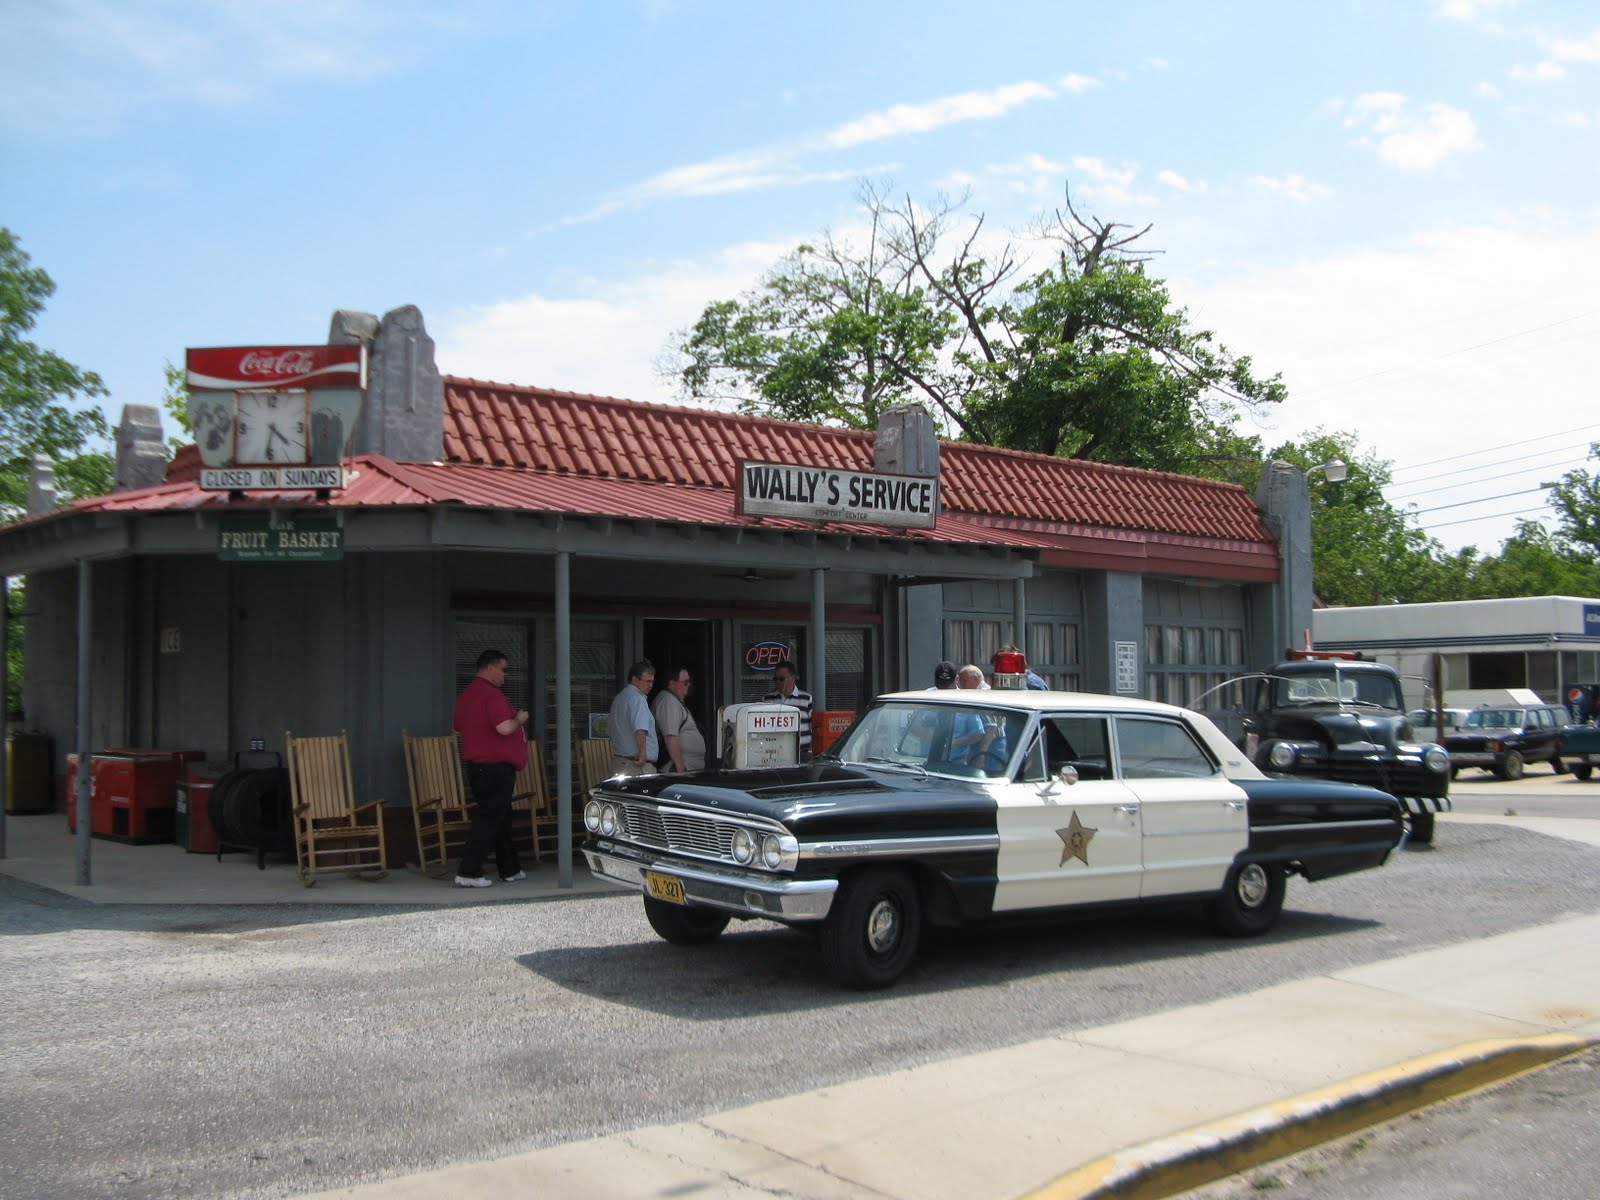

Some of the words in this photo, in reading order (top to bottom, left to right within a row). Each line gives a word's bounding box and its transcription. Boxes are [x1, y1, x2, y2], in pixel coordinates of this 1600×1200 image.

[205, 471, 252, 487] CLOSED
[260, 471, 277, 487] ON
[285, 470, 337, 486] SUNDAYS
[747, 466, 840, 506] WALLY'S
[848, 475, 931, 514] SERVICE
[815, 509, 842, 518] COMFORT
[845, 510, 868, 519] CENTER
[221, 532, 269, 548] FRUIT
[279, 532, 340, 548] BASKET
[746, 647, 791, 665] OPEN
[754, 716, 795, 728] HI-TEST
